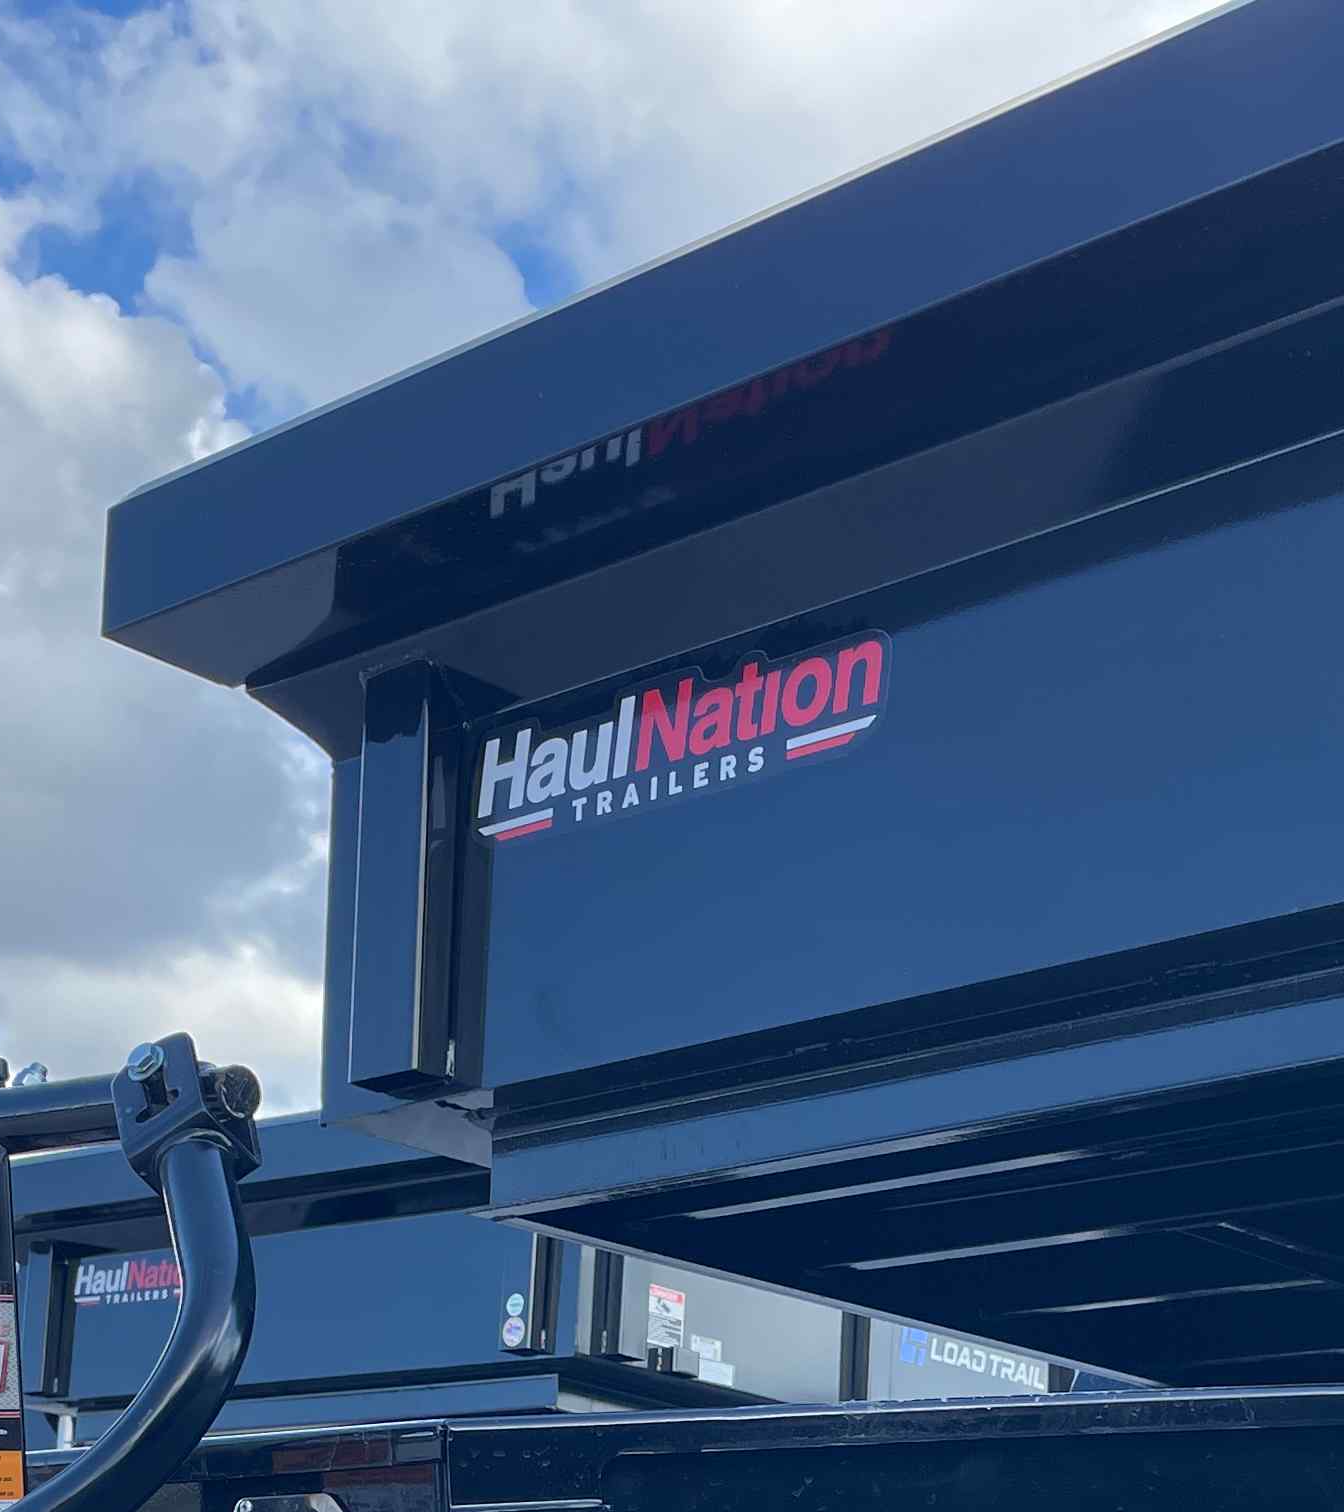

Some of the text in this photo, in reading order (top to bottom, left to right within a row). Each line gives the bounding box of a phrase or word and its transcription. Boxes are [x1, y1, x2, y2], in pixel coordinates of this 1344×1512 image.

[477, 640, 884, 819] HaulNation
[572, 746, 766, 822] TRAILERS
[106, 1288, 169, 1304] TRAILERS
[930, 1338, 1045, 1390] LOAD TRAIL
